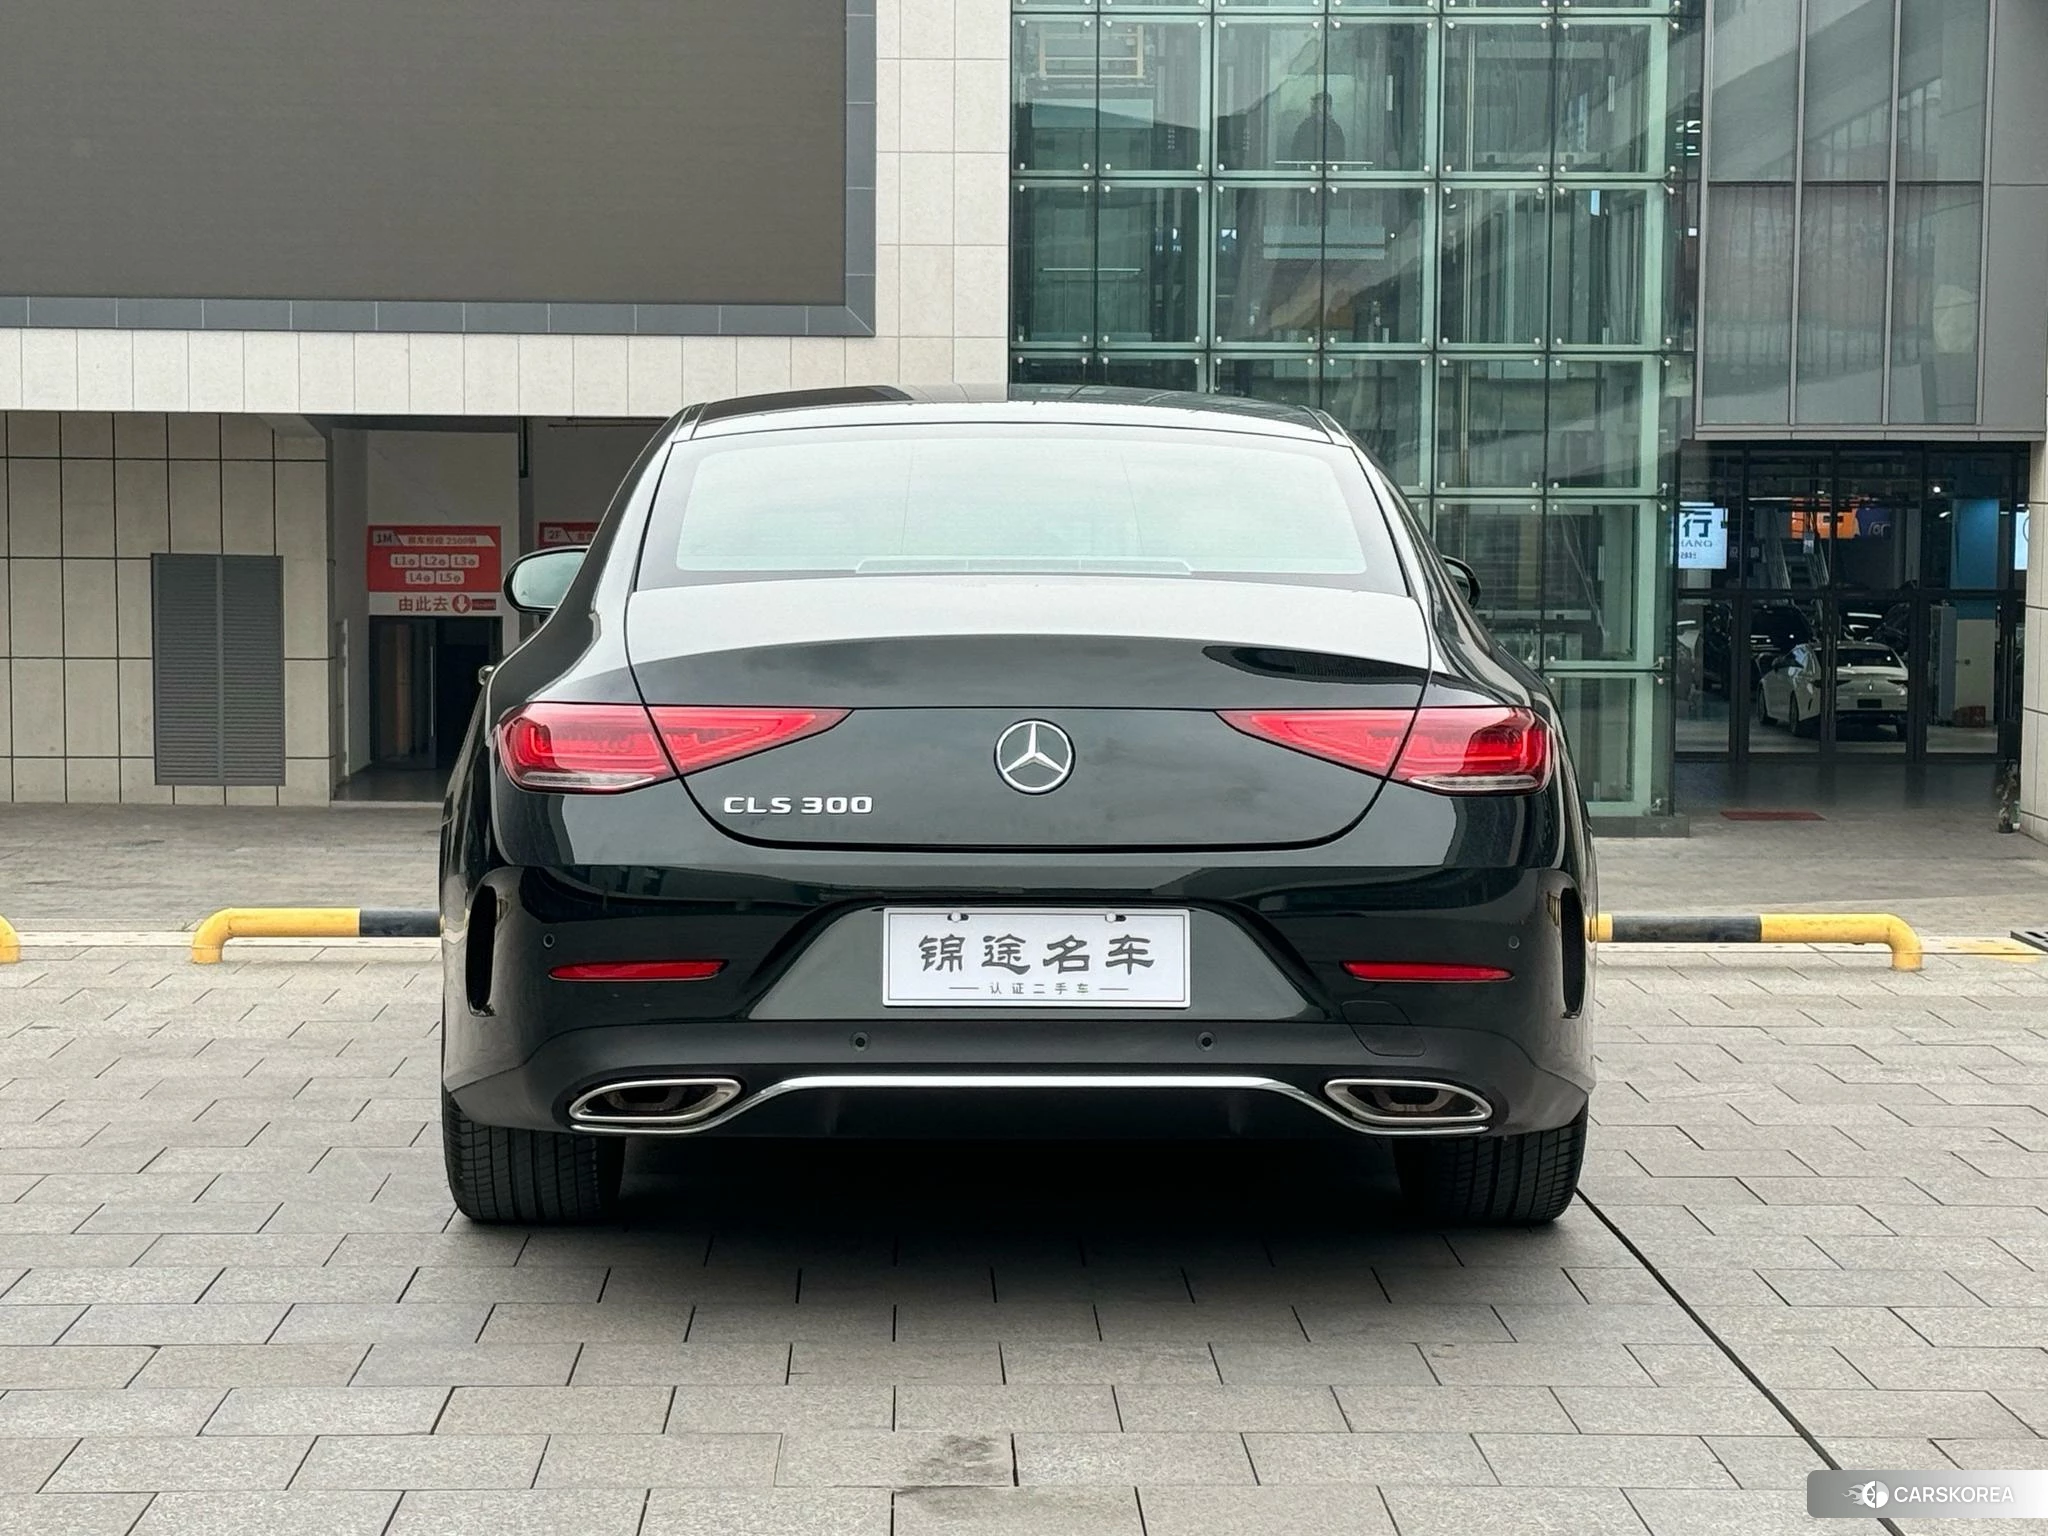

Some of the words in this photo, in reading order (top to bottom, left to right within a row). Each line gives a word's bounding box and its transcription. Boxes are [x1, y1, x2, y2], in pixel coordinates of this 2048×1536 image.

[399, 595, 449, 612] 由此去
[723, 797, 792, 814] CLS
[801, 796, 873, 814] 300
[918, 933, 1154, 975] 锦途名车
[988, 982, 1089, 995] 认证二手车
